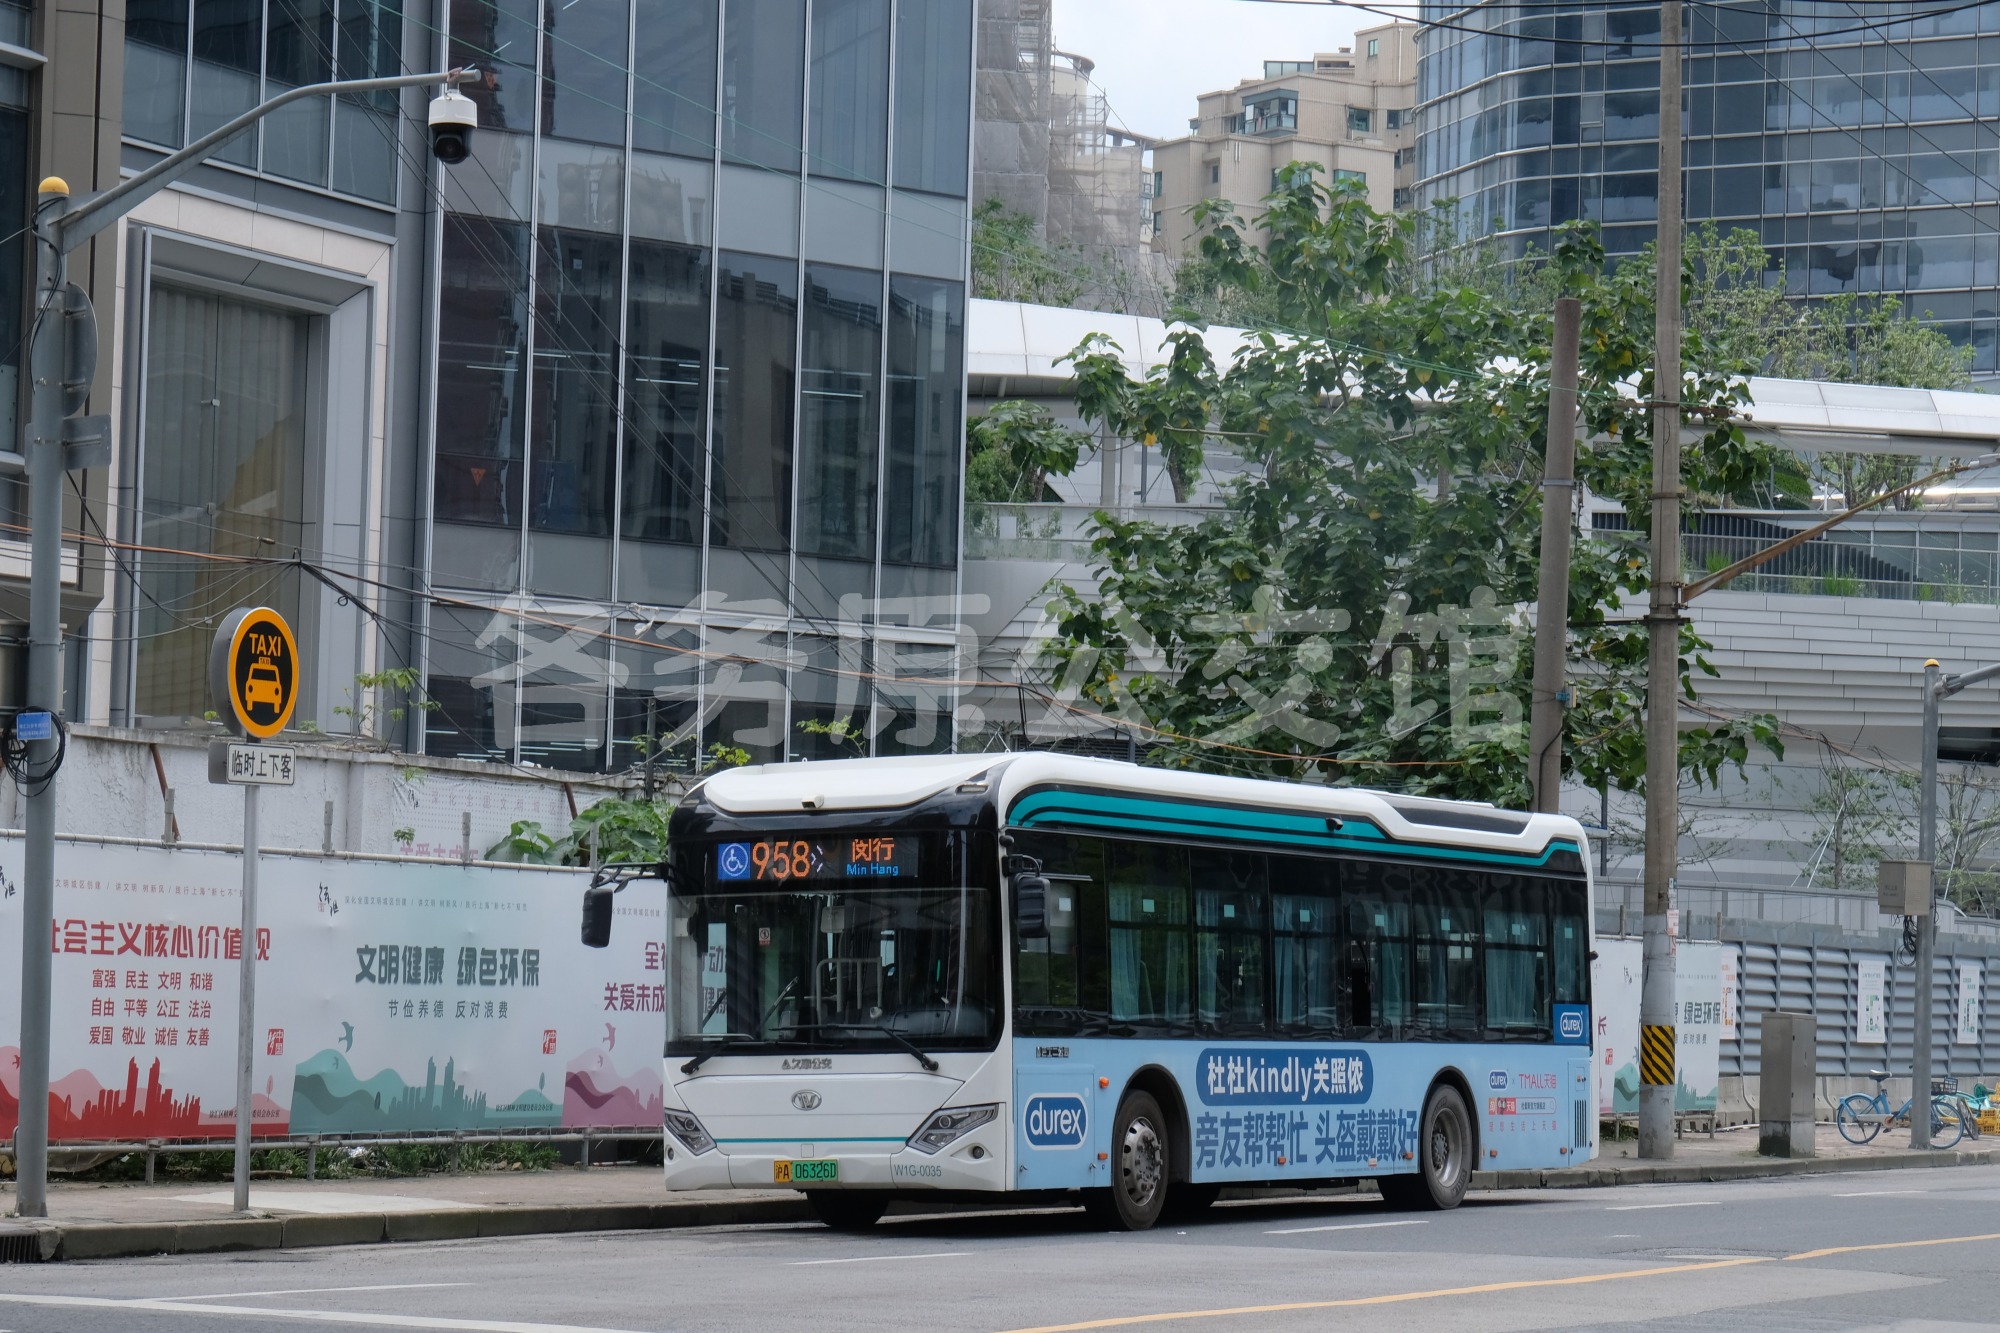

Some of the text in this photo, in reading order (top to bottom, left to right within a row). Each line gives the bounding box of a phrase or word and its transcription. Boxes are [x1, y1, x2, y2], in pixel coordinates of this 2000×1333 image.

[249, 633, 282, 657] TAXI
[260, 658, 270, 666] TAXI
[231, 749, 292, 780] 临时上下客
[753, 840, 810, 880] 958
[851, 838, 895, 862] 闵行
[846, 863, 899, 877] Min Hang
[355, 945, 540, 986] 文明健康 绿色环保
[92, 968, 213, 992] 富强 民主 文明 和谐
[91, 998, 212, 1019] 自由 平等 公正 法治
[388, 999, 509, 1019] 节俭养德 反对浪费
[1684, 1001, 1721, 1025] 绿色环保
[89, 1026, 210, 1047] 爱国 敬业 诚信 友善
[1562, 1015, 1582, 1034] durex
[1207, 1056, 1365, 1102] 杜杜kindly关照侬
[1490, 1073, 1507, 1087] durex
[1029, 1101, 1083, 1138] durex
[1196, 1109, 1308, 1169] 旁友帮帮忙
[1315, 1108, 1418, 1165] 头盔戴戴好
[894, 1164, 942, 1177] W1G-0035
